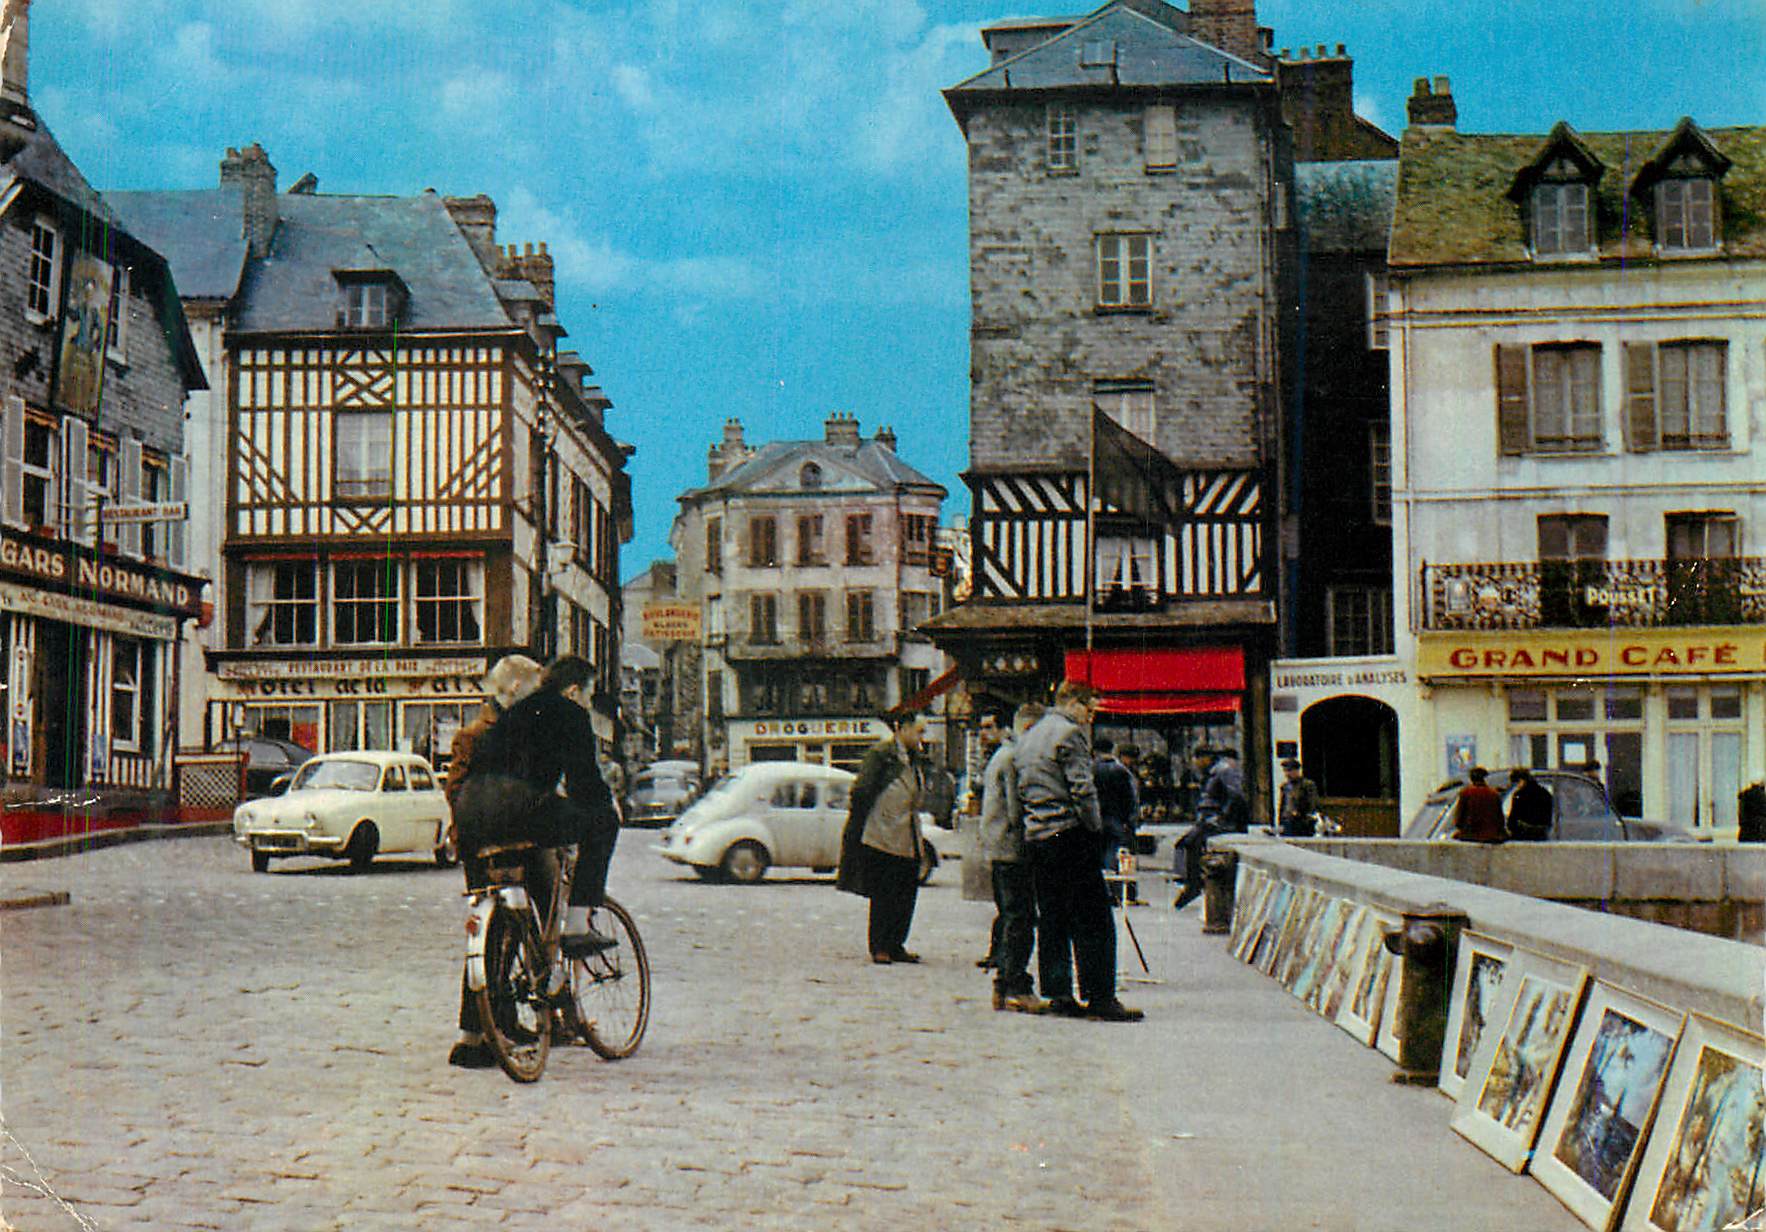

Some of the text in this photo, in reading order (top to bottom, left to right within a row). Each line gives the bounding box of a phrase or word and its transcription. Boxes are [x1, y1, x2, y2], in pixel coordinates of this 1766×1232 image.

[1, 538, 189, 607] GARS NORMAND
[1450, 647, 1599, 669] GRAND
[1621, 641, 1738, 666] CAFÉ
[289, 659, 353, 673] RESTAURANT
[374, 659, 388, 672] LA
[1275, 673, 1343, 688] LABORATOIRE
[754, 720, 872, 735] DROGUERIE
